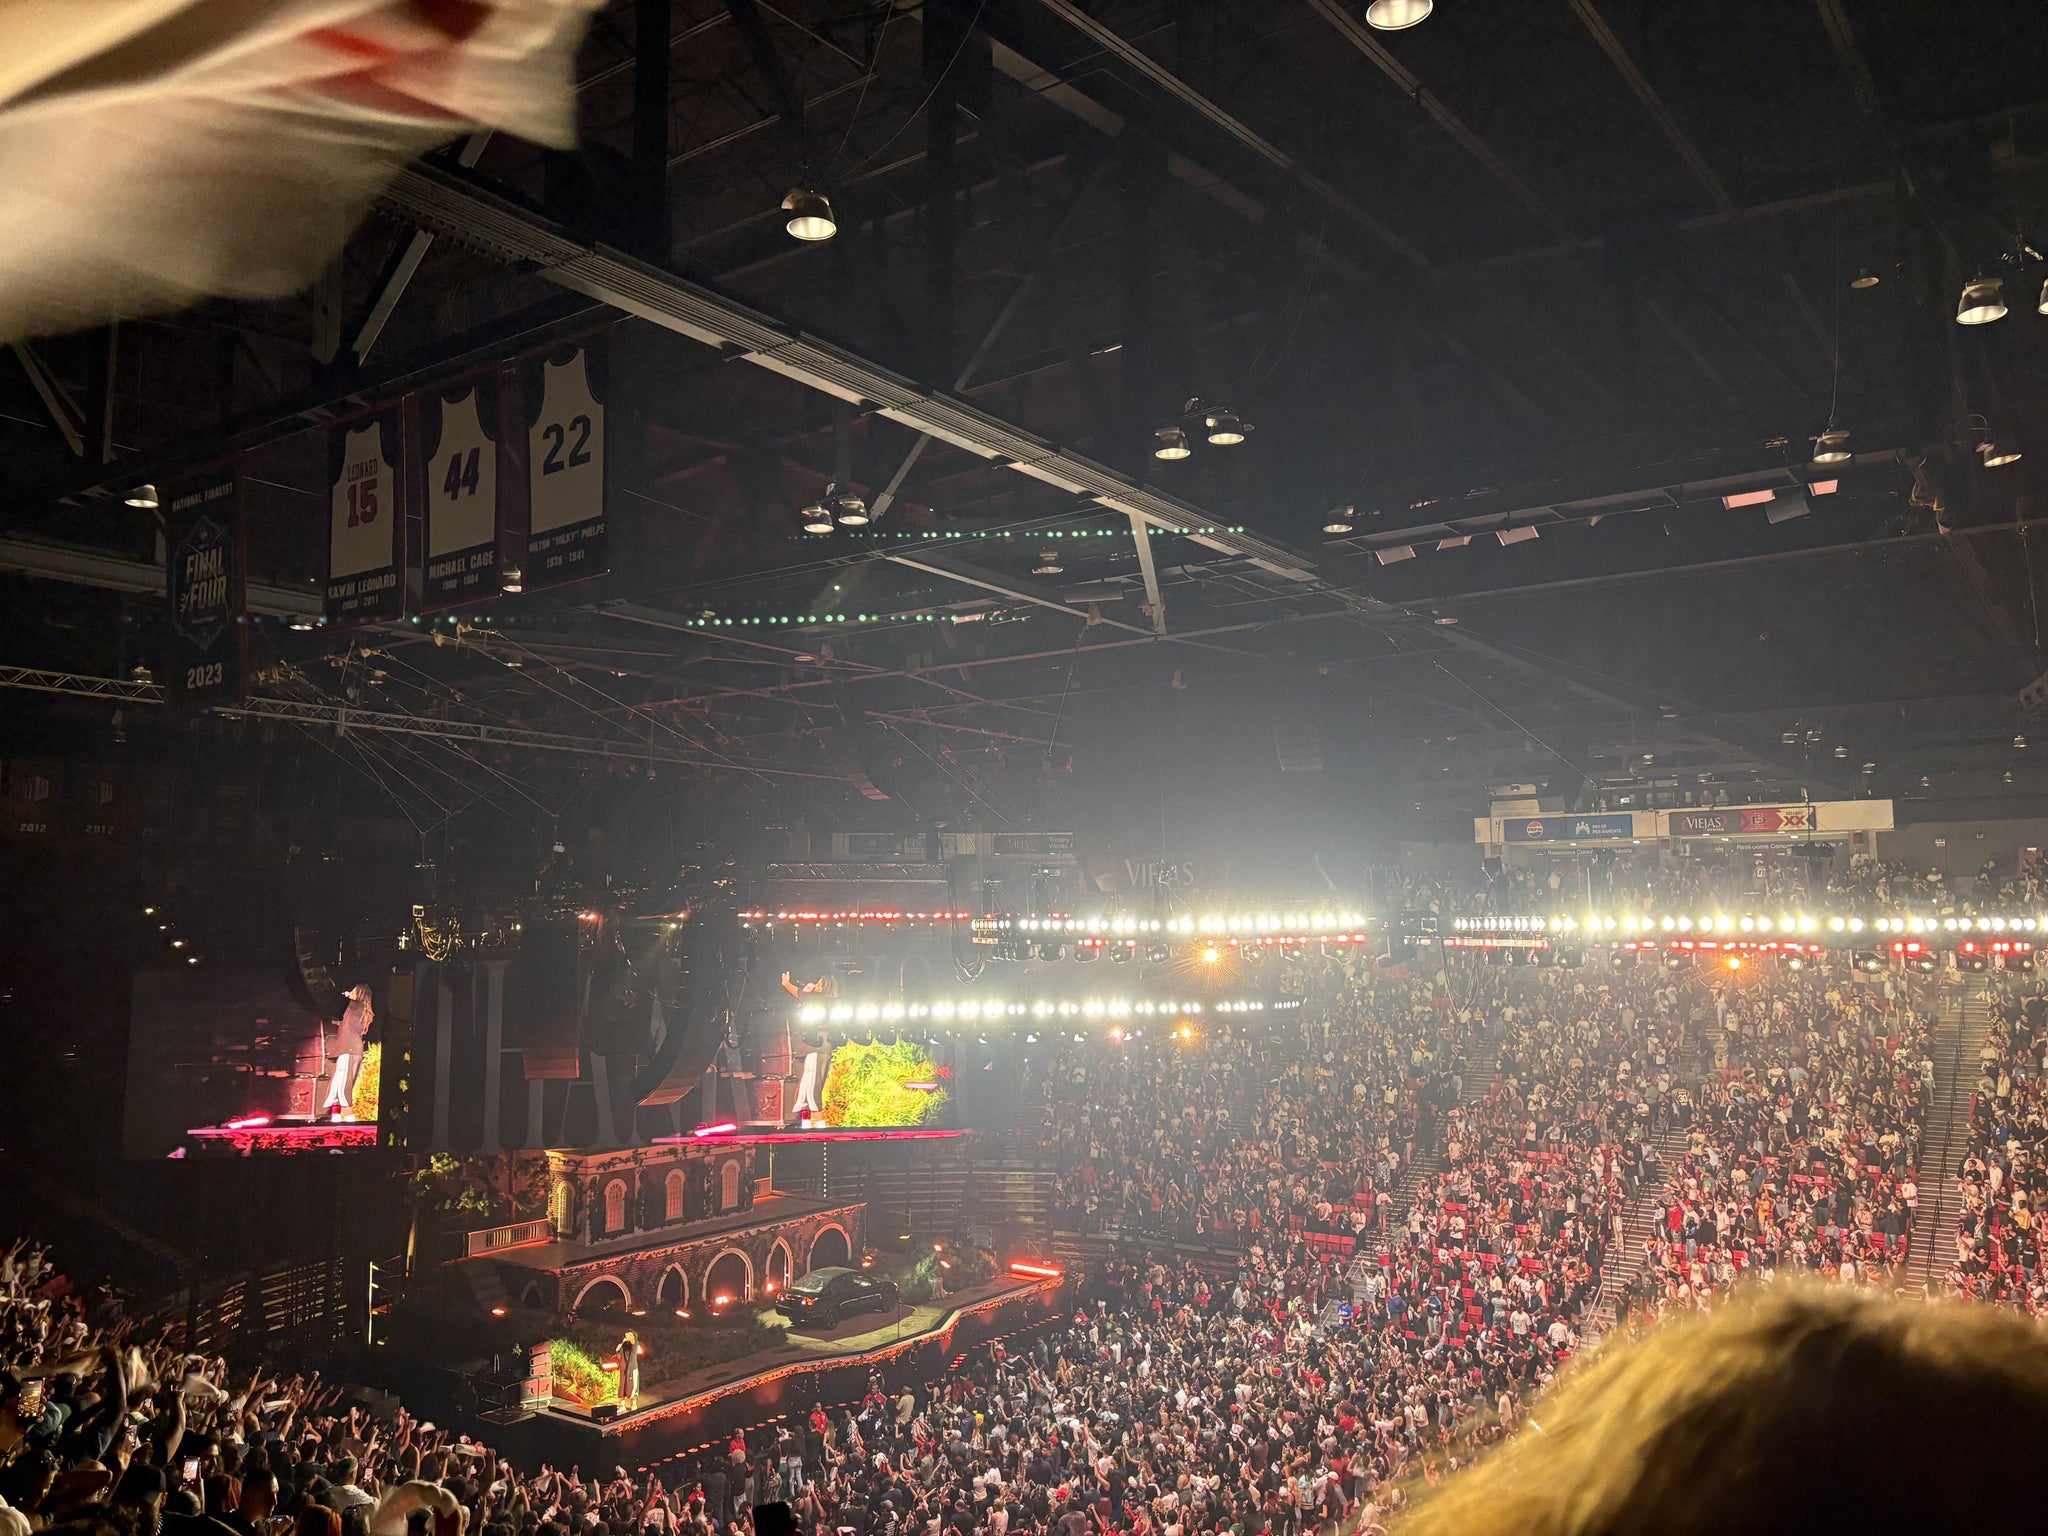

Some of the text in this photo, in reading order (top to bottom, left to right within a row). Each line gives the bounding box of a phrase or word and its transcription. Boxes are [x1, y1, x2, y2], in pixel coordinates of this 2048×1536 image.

[543, 414, 591, 475] 22
[347, 458, 378, 482] LEONARD
[444, 446, 480, 500] 44
[172, 493, 203, 512] NATIONAL
[347, 478, 378, 528] 15
[581, 523, 605, 539] PHELPS
[185, 546, 224, 578] FINAL
[429, 551, 494, 579] MICHAEL CAGE
[189, 576, 227, 611] FOUR
[358, 573, 397, 593] LEONARD
[187, 662, 223, 689] 2023
[1686, 816, 1721, 830] VIEJAS
